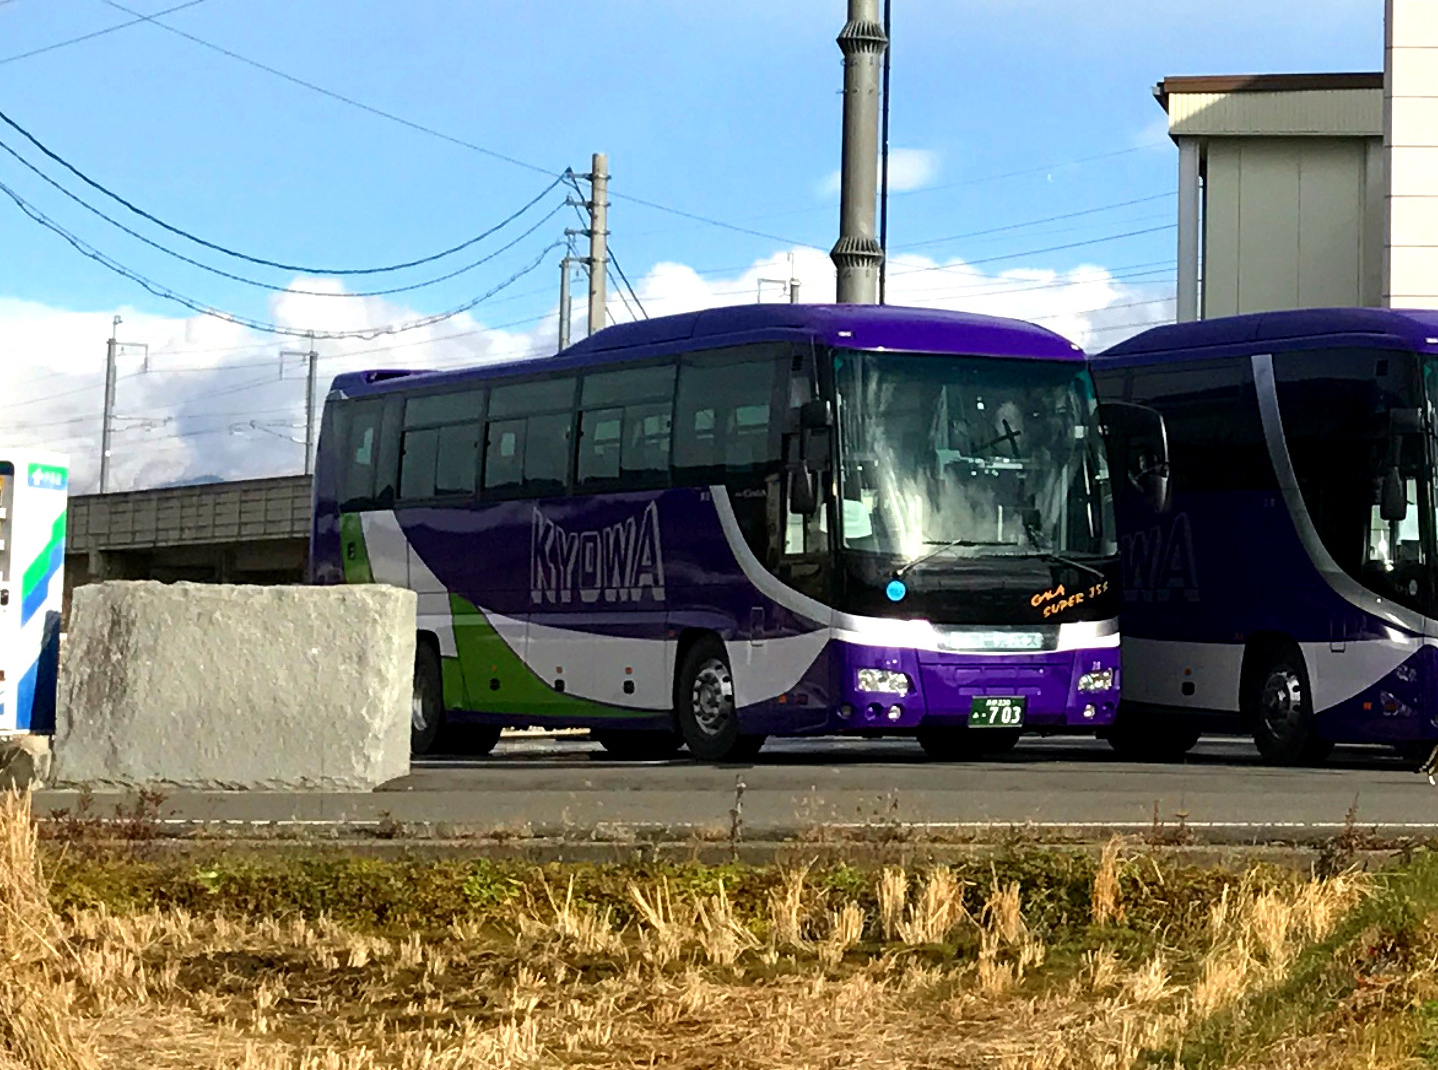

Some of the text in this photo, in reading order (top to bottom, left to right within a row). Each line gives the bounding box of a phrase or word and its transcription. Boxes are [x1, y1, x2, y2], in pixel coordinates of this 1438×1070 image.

[531, 500, 666, 603] KYOWA
[1043, 592, 1084, 618] SUPER
[989, 706, 1021, 724] 703
